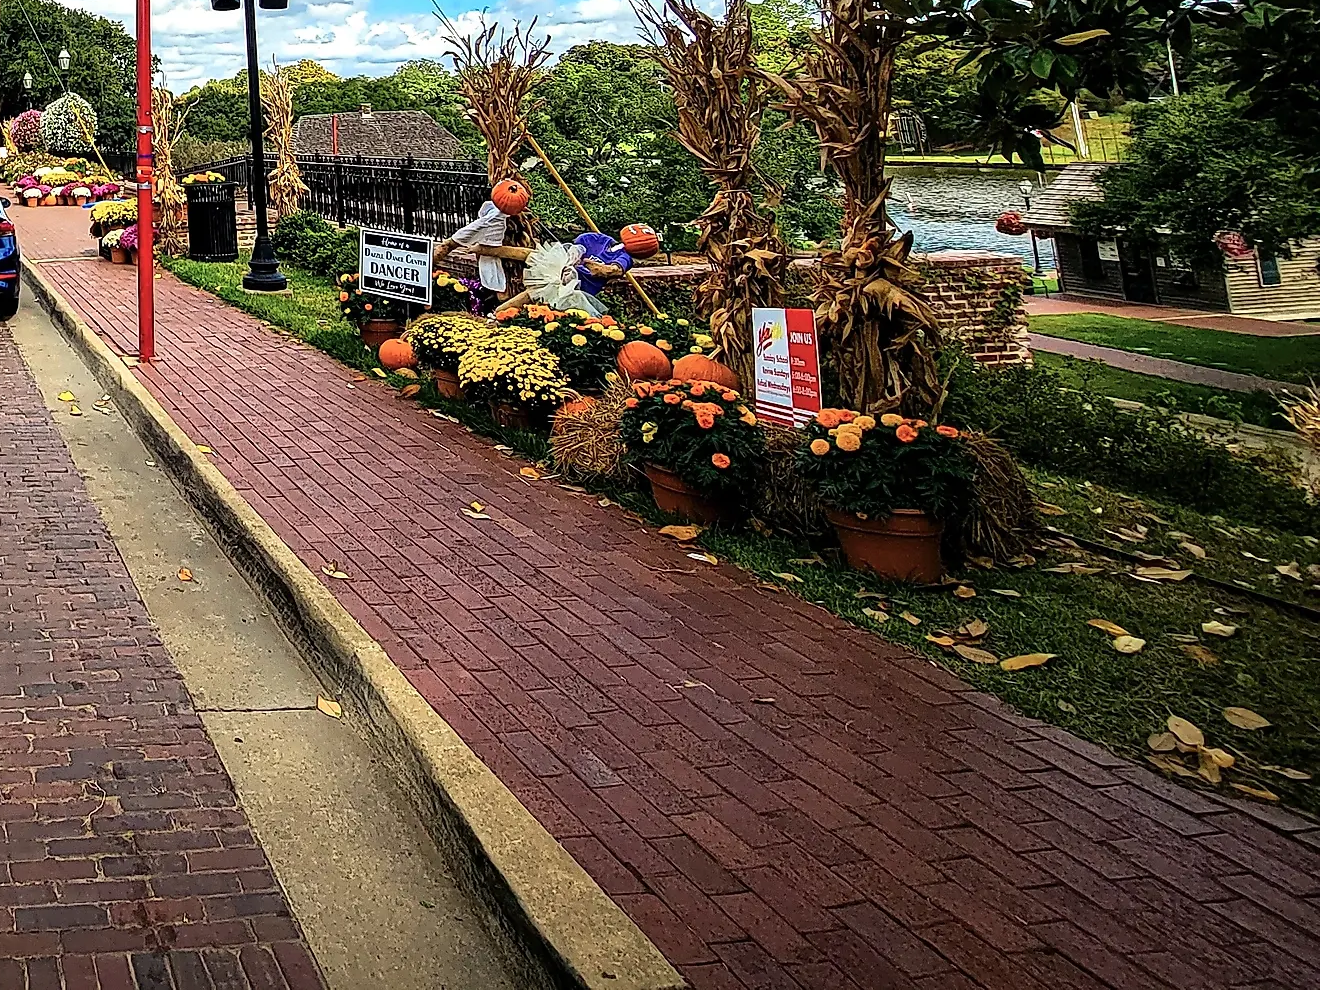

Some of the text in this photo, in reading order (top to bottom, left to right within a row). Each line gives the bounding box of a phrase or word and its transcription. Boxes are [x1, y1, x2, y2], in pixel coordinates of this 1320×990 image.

[370, 262, 420, 282] DANCER
[790, 332, 812, 344] JOIN US
